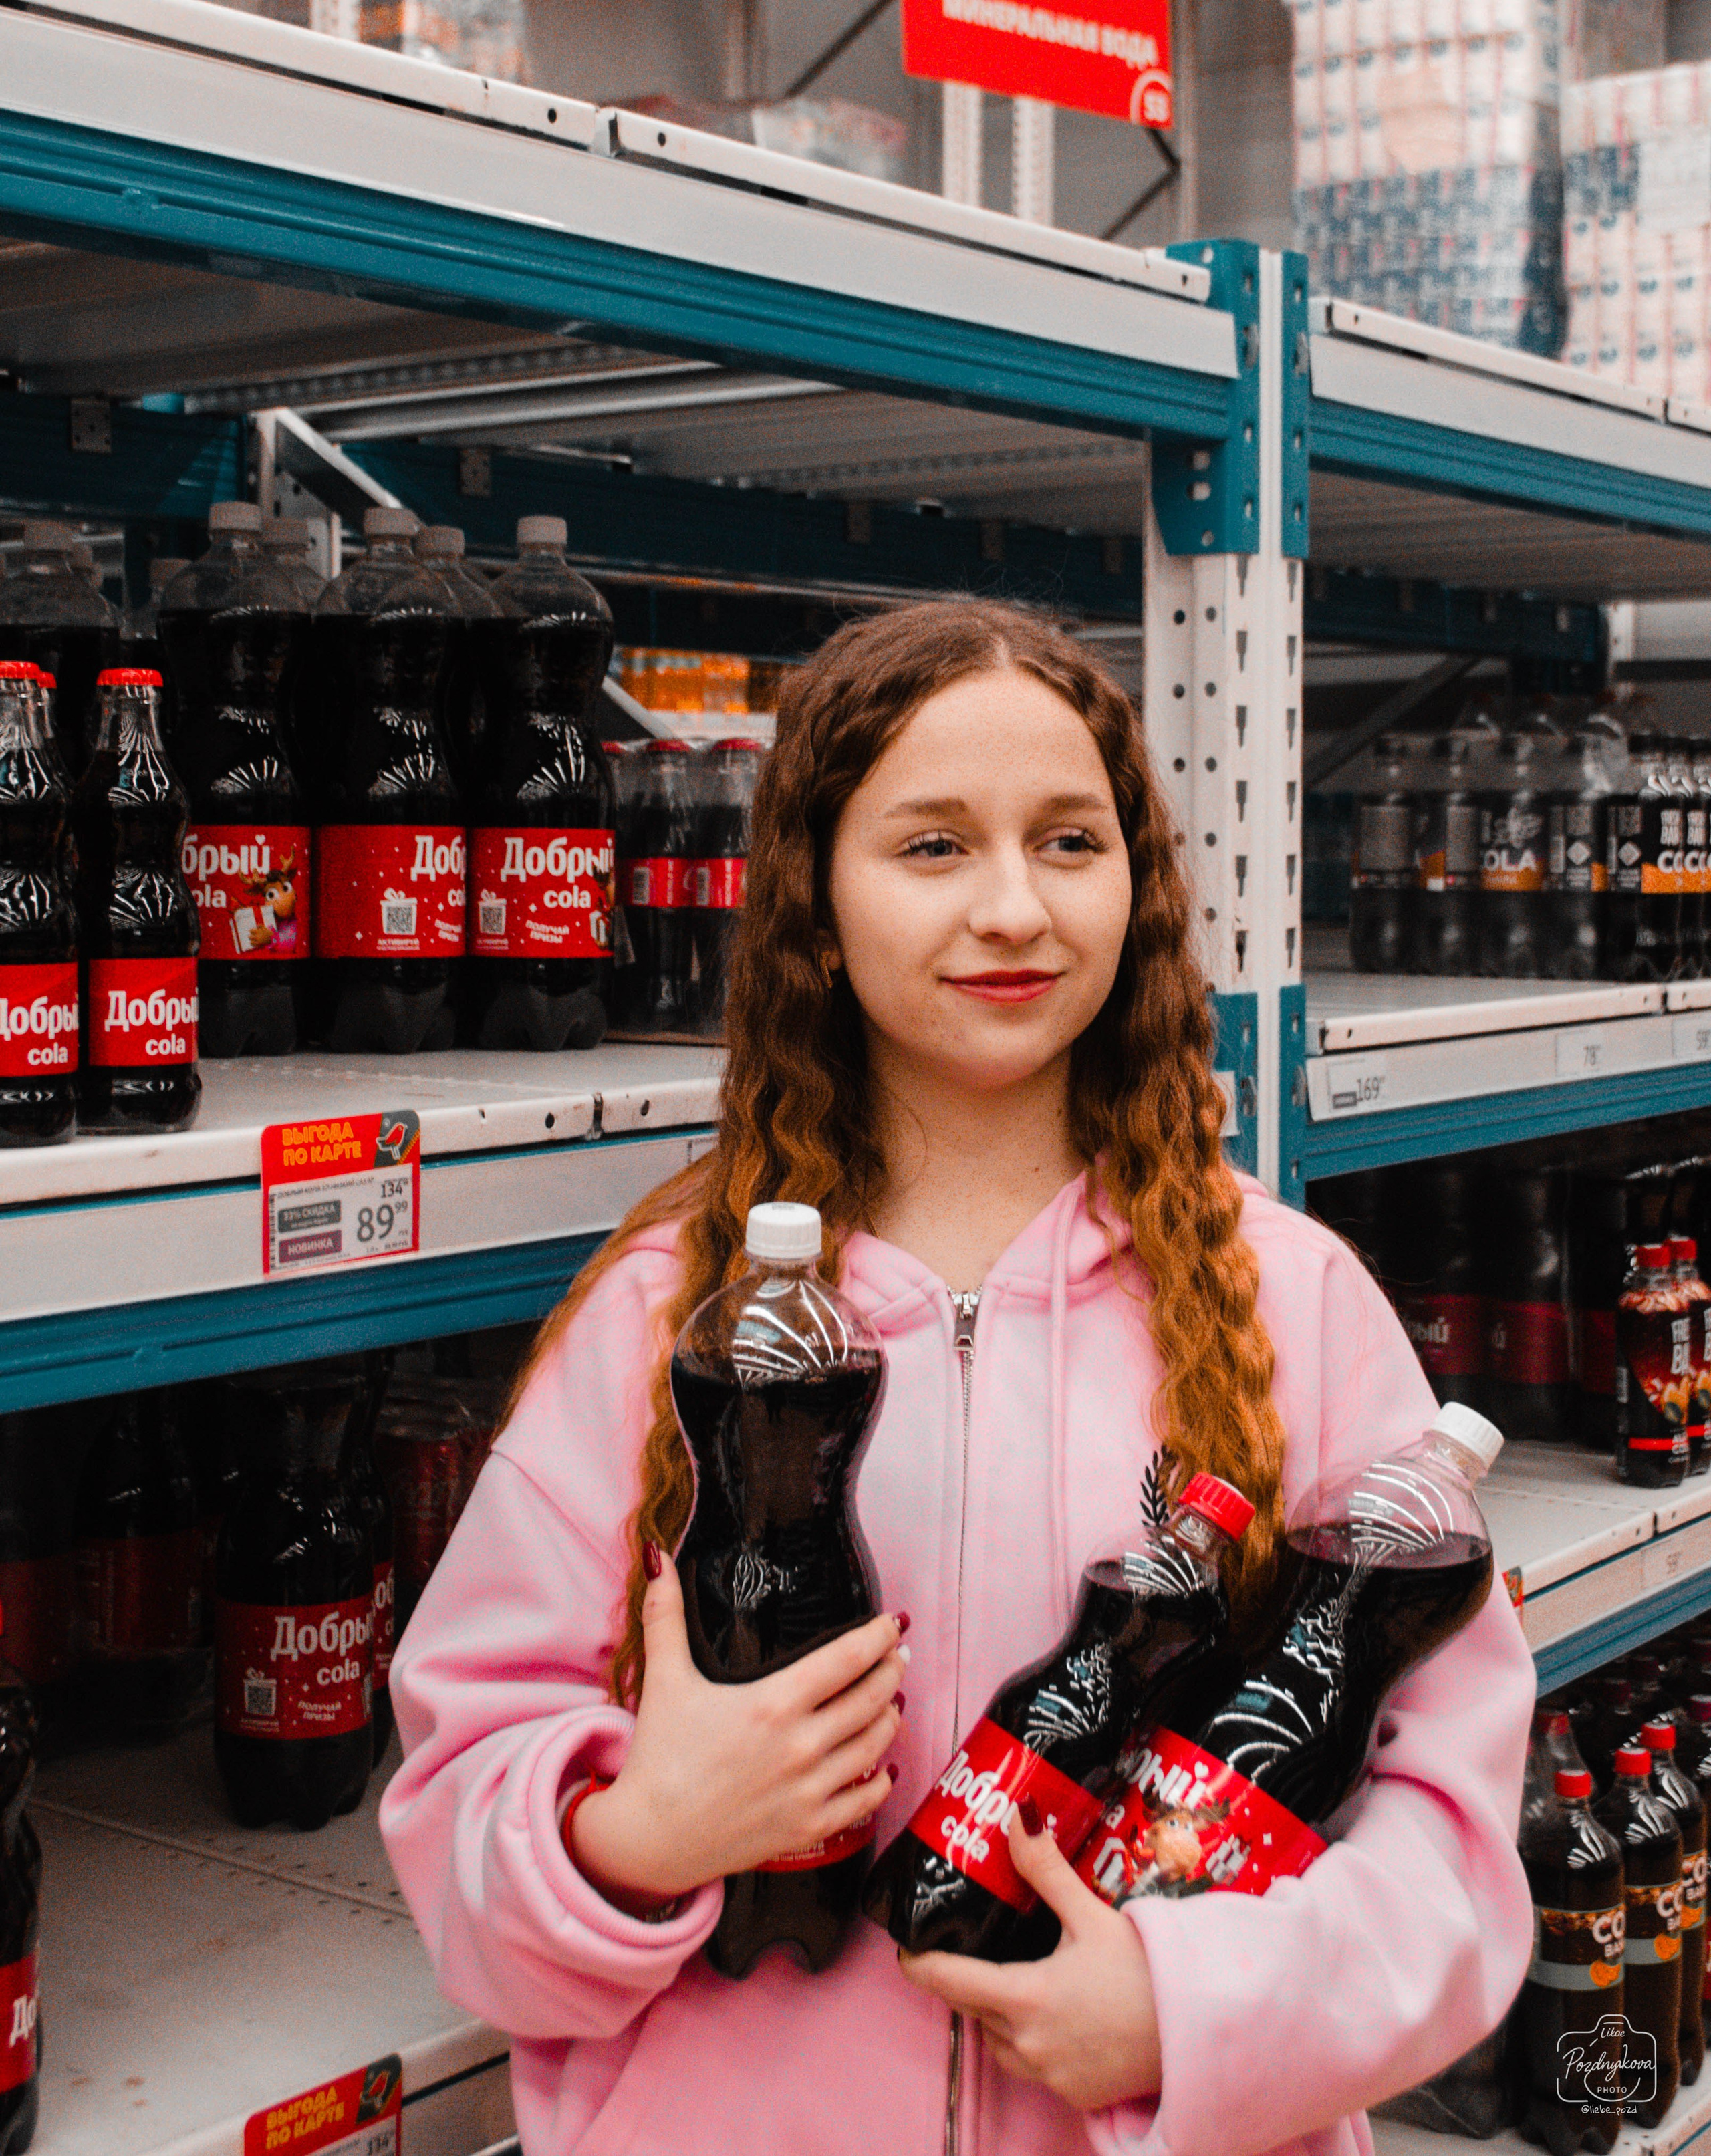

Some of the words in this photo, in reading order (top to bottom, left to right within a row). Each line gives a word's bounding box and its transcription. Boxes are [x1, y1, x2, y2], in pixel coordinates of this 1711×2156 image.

[181, 833, 271, 882] брый
[410, 835, 466, 882] Доб
[1480, 849, 1537, 872] OLA
[191, 884, 227, 909] ola
[543, 884, 591, 908] cola
[27, 1042, 68, 1065] cola
[145, 1033, 186, 1056] cola
[282, 1121, 354, 1146] ВЫГОДА
[283, 1148, 308, 1166] ПО
[311, 1141, 362, 1163] КАРТЕ
[356, 1204, 394, 1243] 89
[288, 1238, 334, 1256] НОВИНКА
[316, 1659, 360, 1686] cola
[936, 1748, 1021, 1837] Добр
[940, 1815, 990, 1863] cola
[267, 2086, 338, 2131] ВЫГОДА
[265, 2125, 291, 2151] ПО
[293, 2101, 345, 2139] КАРТЕ
